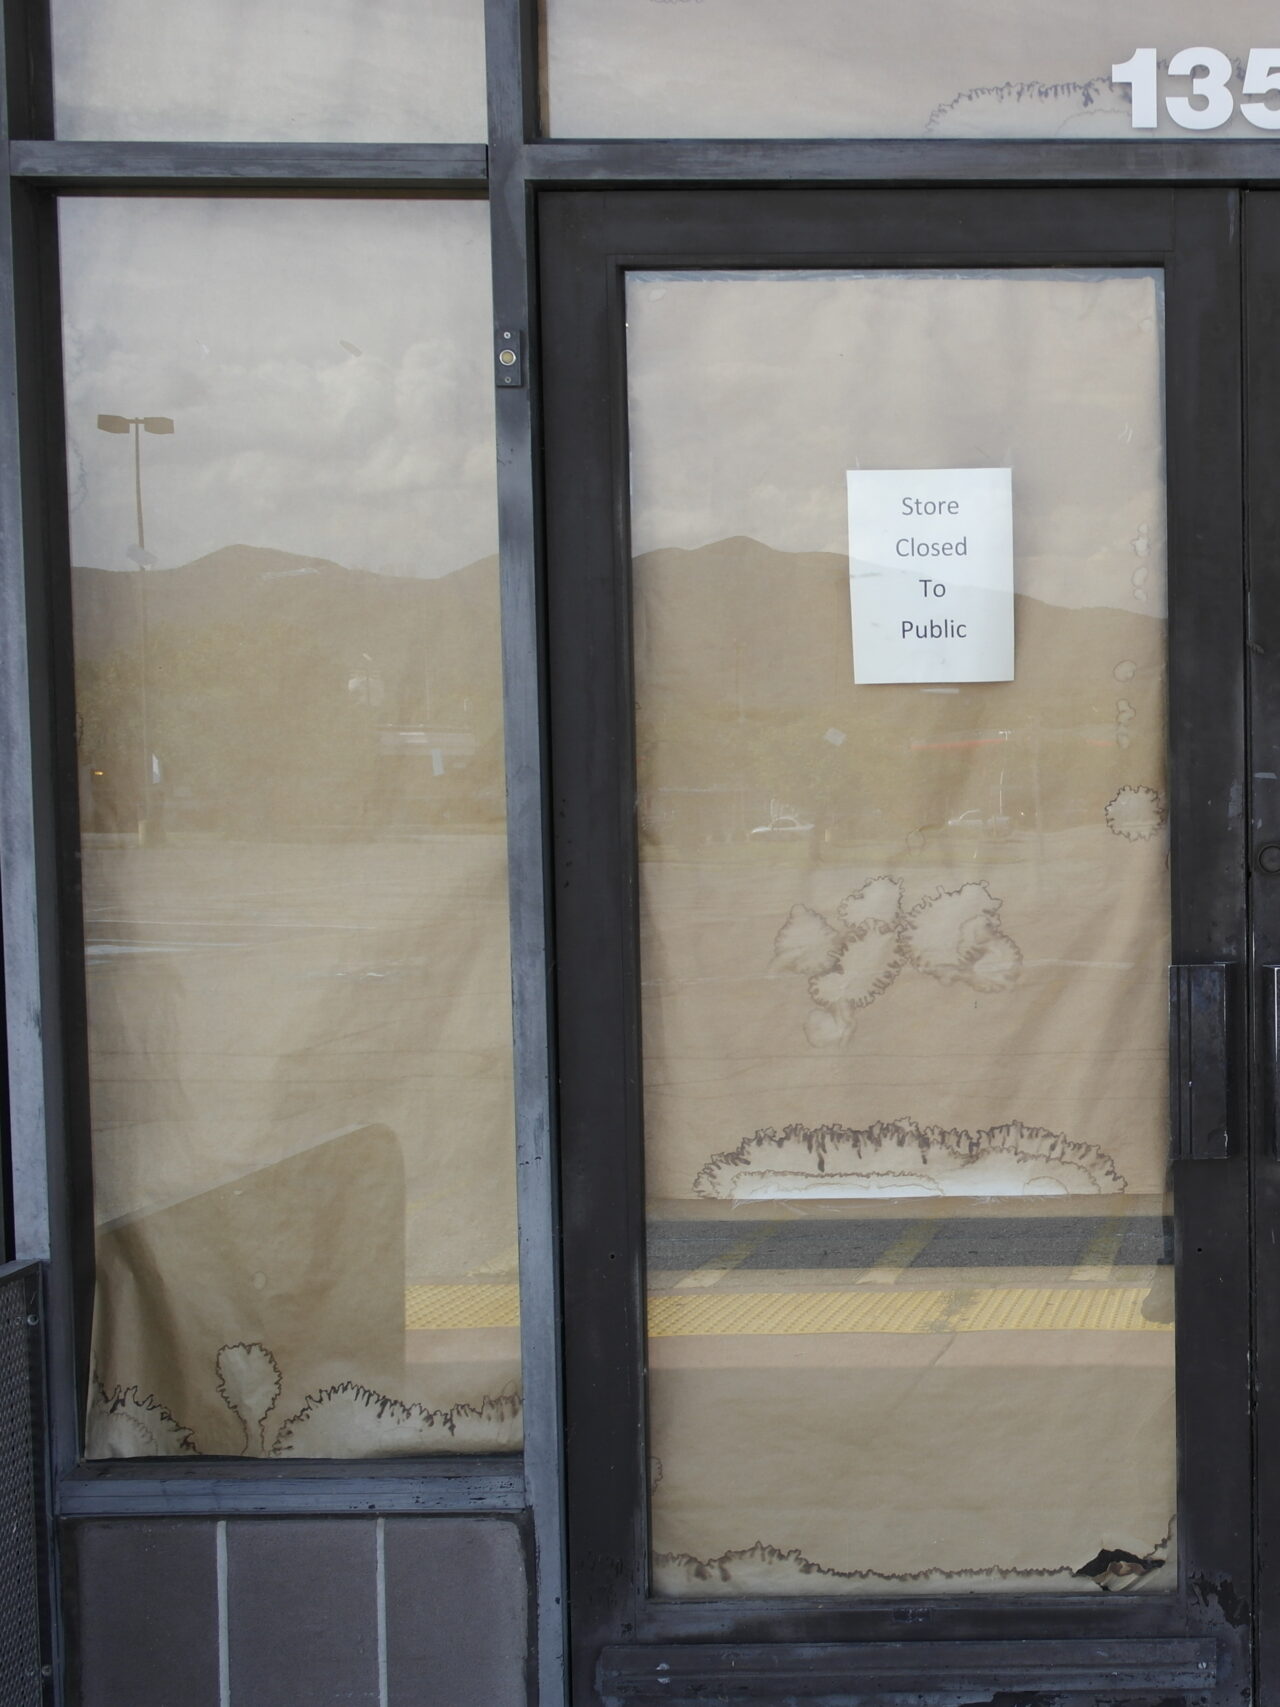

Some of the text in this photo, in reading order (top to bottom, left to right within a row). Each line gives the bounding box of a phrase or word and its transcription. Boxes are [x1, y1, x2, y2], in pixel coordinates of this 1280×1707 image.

[902, 497, 960, 516] Store
[895, 537, 967, 557] Closed
[919, 579, 946, 598] To
[902, 619, 967, 639] Public
